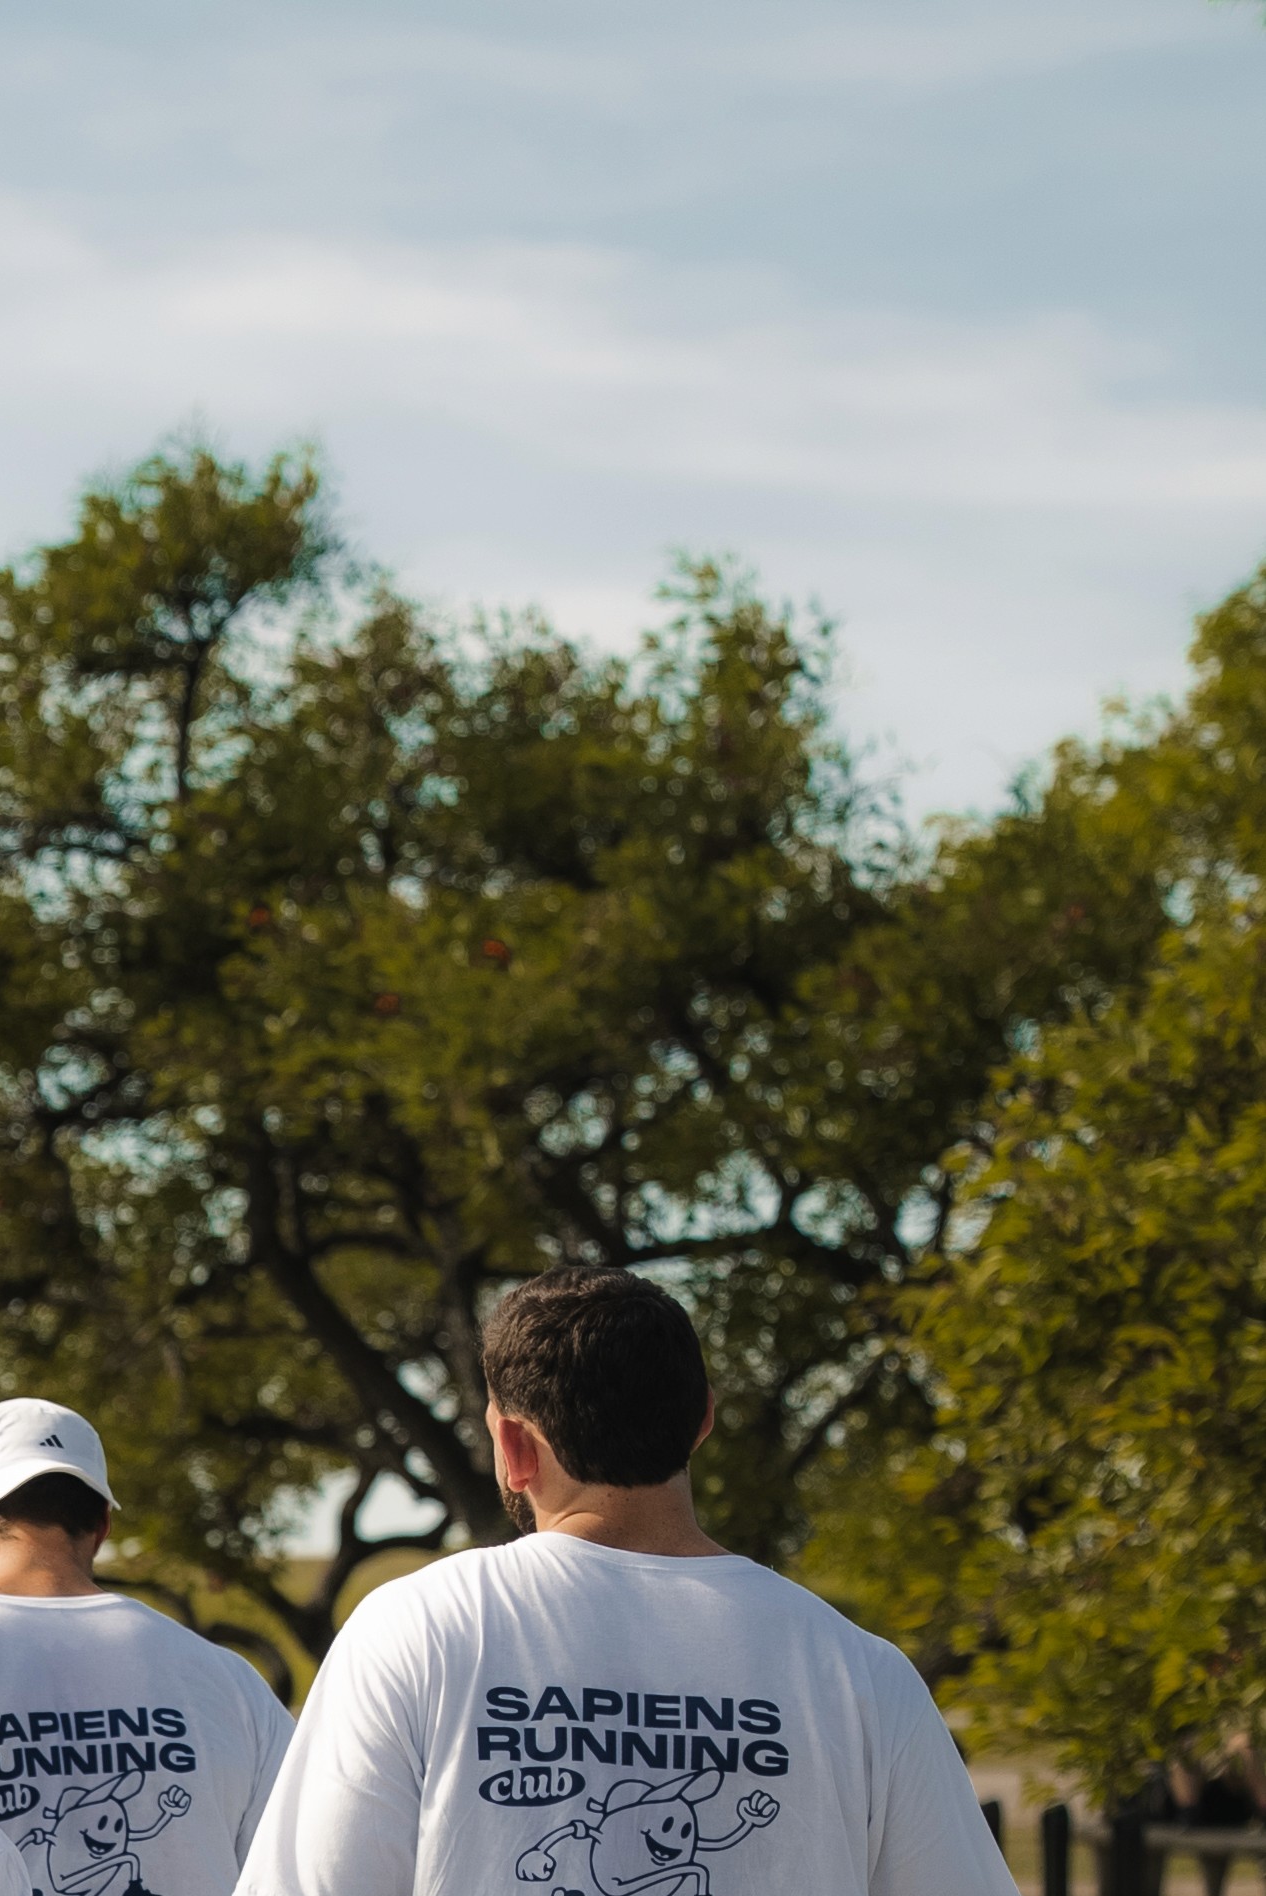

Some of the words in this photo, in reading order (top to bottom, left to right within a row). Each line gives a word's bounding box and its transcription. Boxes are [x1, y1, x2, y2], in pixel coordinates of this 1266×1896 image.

[485, 1686, 782, 1735] SAPIENS
[477, 1726, 789, 1777] RUNNING
[489, 1767, 573, 1801] club
